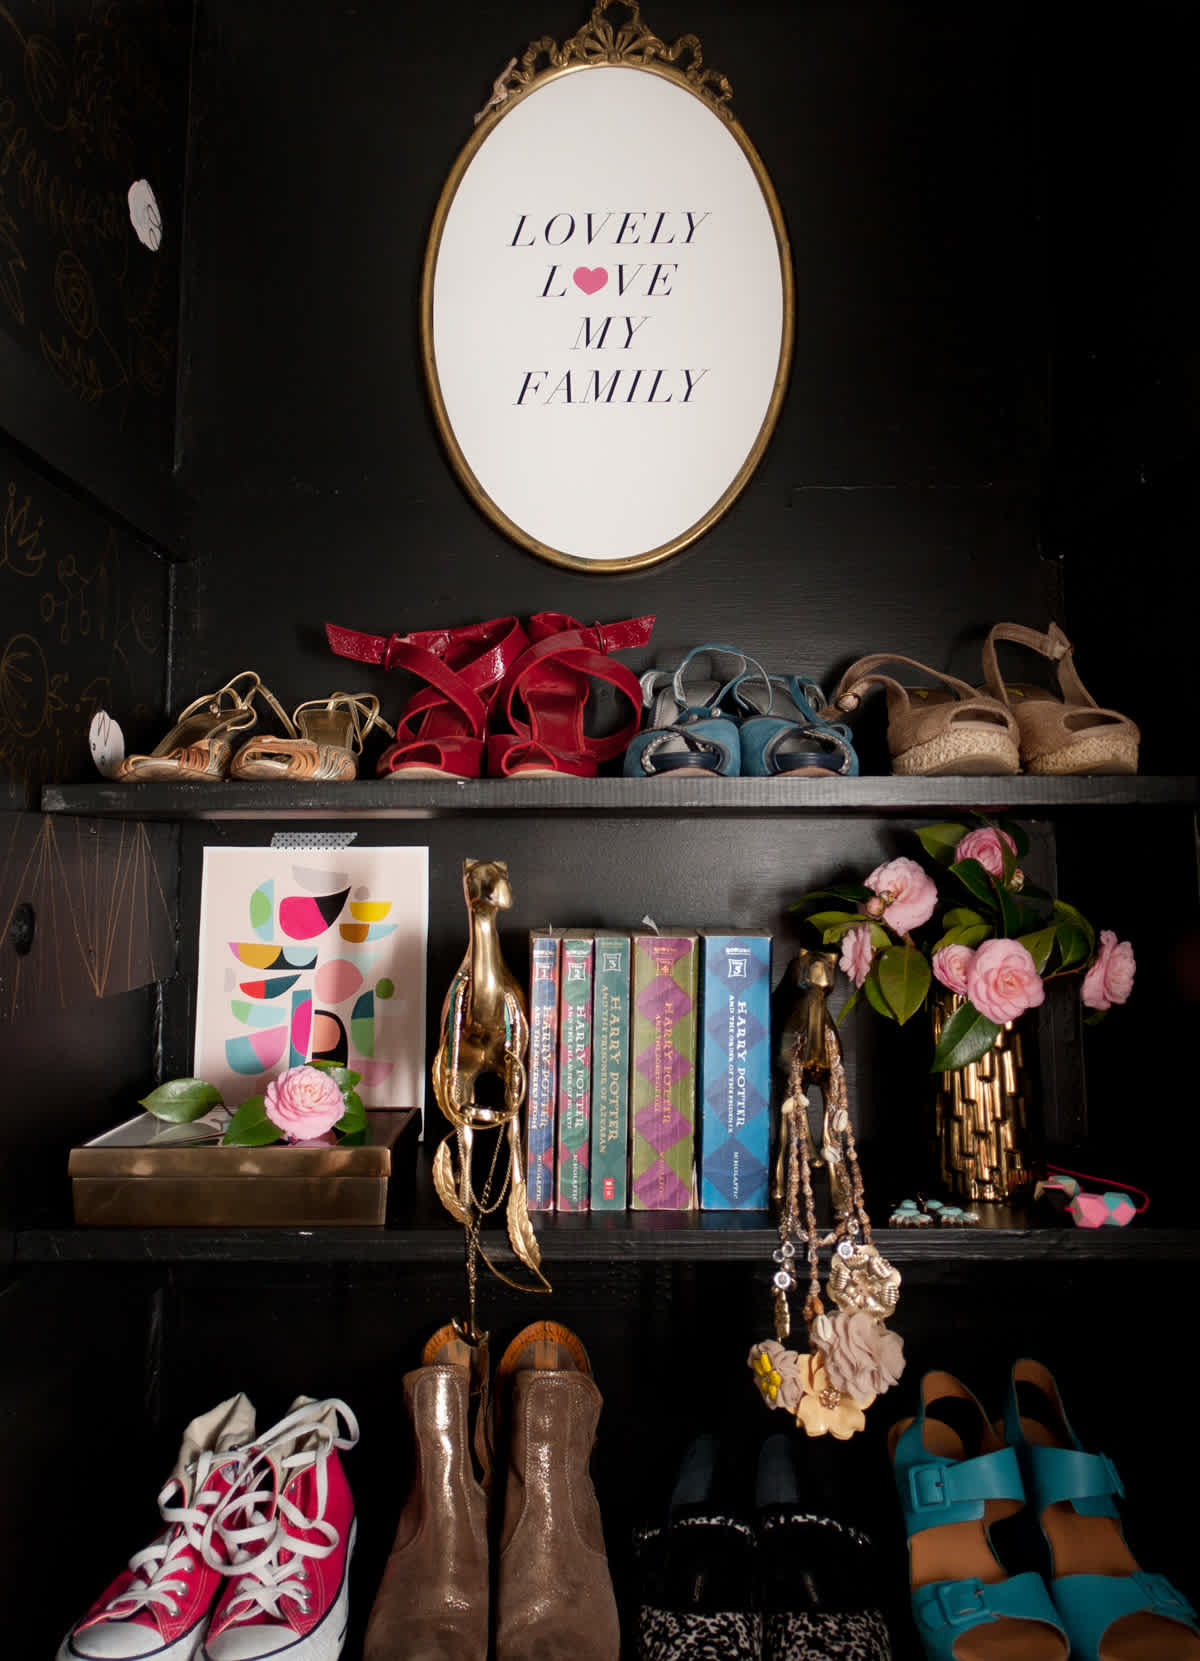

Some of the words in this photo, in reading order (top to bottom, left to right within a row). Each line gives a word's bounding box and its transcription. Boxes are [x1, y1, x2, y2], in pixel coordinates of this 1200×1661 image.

[505, 211, 712, 247] LOVELY
[568, 316, 653, 349] MY
[511, 368, 711, 405] FAMILY
[600, 984, 608, 1008] AND
[600, 1009, 608, 1034] THE
[728, 994, 736, 1014] AND
[540, 1004, 552, 1063] HARRY
[575, 1005, 585, 1064] HARRY
[609, 995, 622, 1065] HARRY
[663, 1002, 674, 1062] HARRY
[736, 1000, 748, 1063] HARRY
[539, 1070, 550, 1129] POTTER
[574, 1069, 585, 1129] POTTER
[599, 1087, 607, 1101] OF
[607, 1072, 620, 1142] POTTER
[735, 1067, 747, 1128] POTTER
[599, 1103, 607, 1153] AZKABAN
